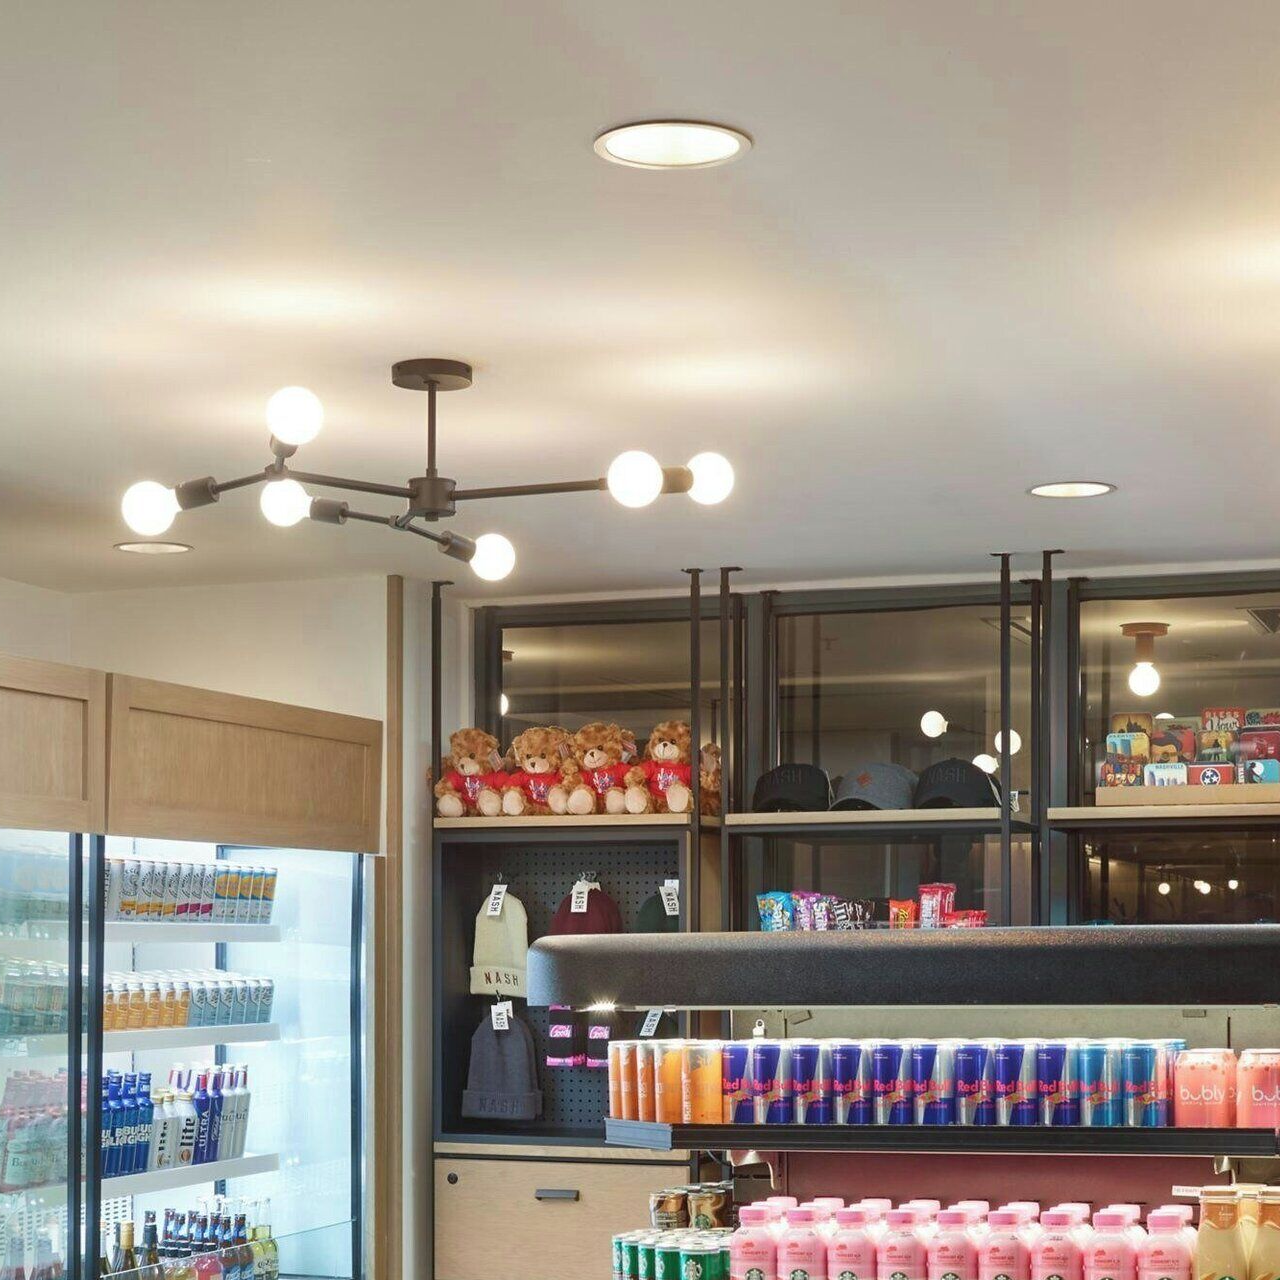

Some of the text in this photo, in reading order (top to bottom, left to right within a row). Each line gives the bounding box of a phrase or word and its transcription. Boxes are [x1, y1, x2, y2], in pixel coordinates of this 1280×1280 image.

[490, 891, 500, 912] NASH
[574, 890, 584, 910] NASH
[664, 892, 677, 913] NASH
[485, 972, 519, 986] NASH
[643, 1012, 658, 1033] NASH
